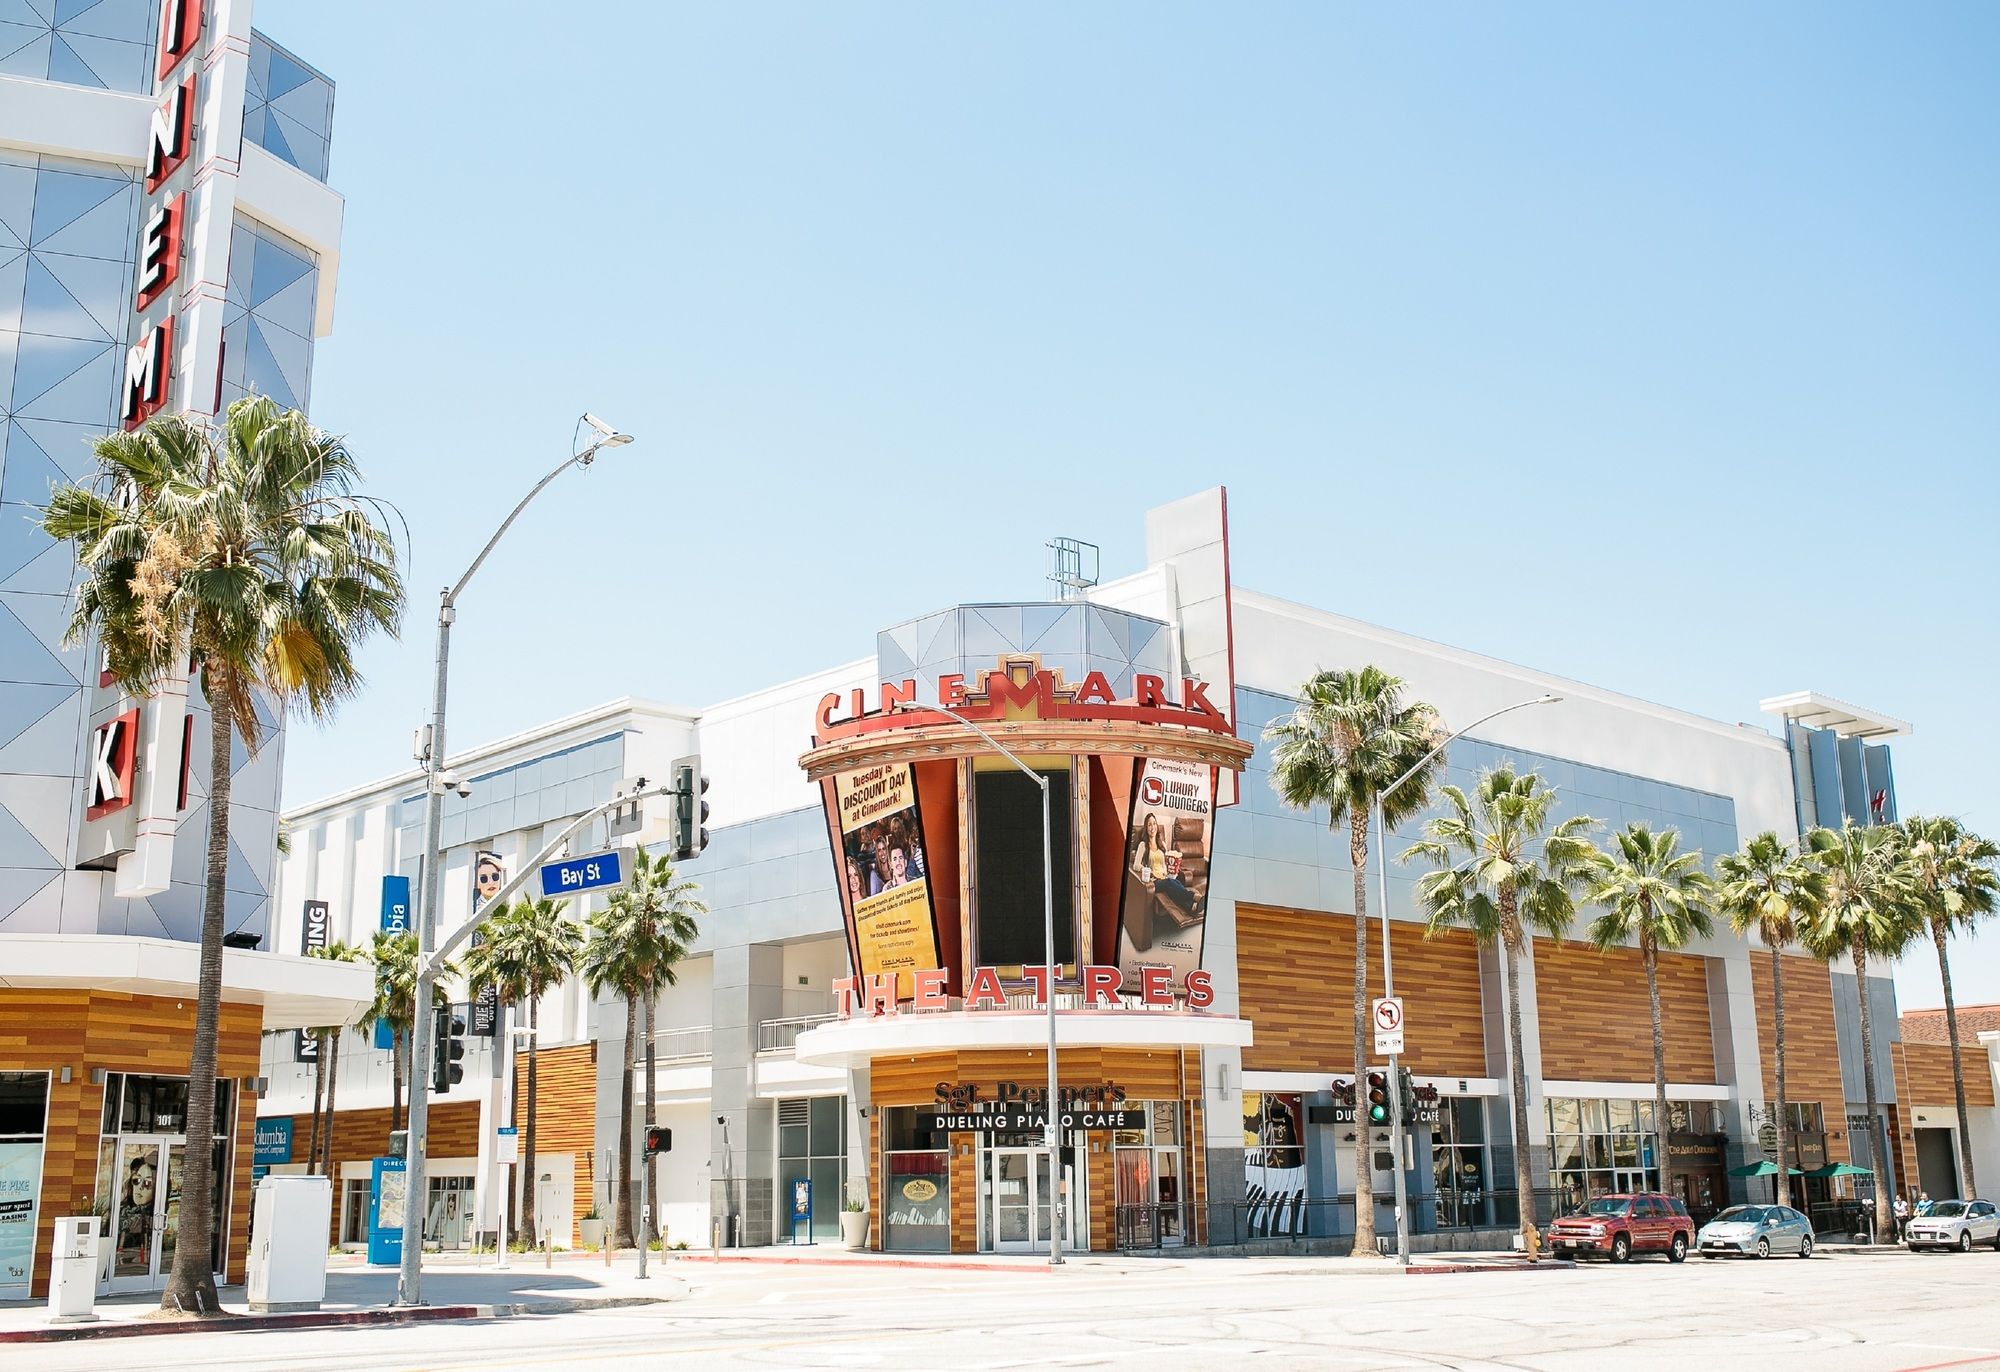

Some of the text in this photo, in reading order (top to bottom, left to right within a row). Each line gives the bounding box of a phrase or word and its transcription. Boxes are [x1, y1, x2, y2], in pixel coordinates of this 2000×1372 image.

[815, 670, 1234, 741] CINEMARK
[852, 764, 892, 788] Tuesday is
[1152, 761, 1187, 776] Cinemark's
[1189, 768, 1203, 778] New
[844, 770, 907, 811] DISCOUNT DAY
[1165, 780, 1199, 798] LUXURY
[852, 789, 901, 822] at Cinemark!
[1164, 794, 1209, 814] LOUNGERS
[561, 862, 601, 887] Bay St
[832, 964, 1215, 1018] THEATRES
[488, 987, 496, 1021] OUTLETS
[475, 1006, 490, 1031] THE
[935, 1081, 988, 1111] Sgt.
[157, 1114, 172, 1126] 101
[936, 1111, 1125, 1129] DUELING PIAO CAFÉ
[1420, 1110, 1440, 1122] CAFÉ
[9, 1180, 30, 1192] PIKE
[13, 1202, 31, 1211] spot
